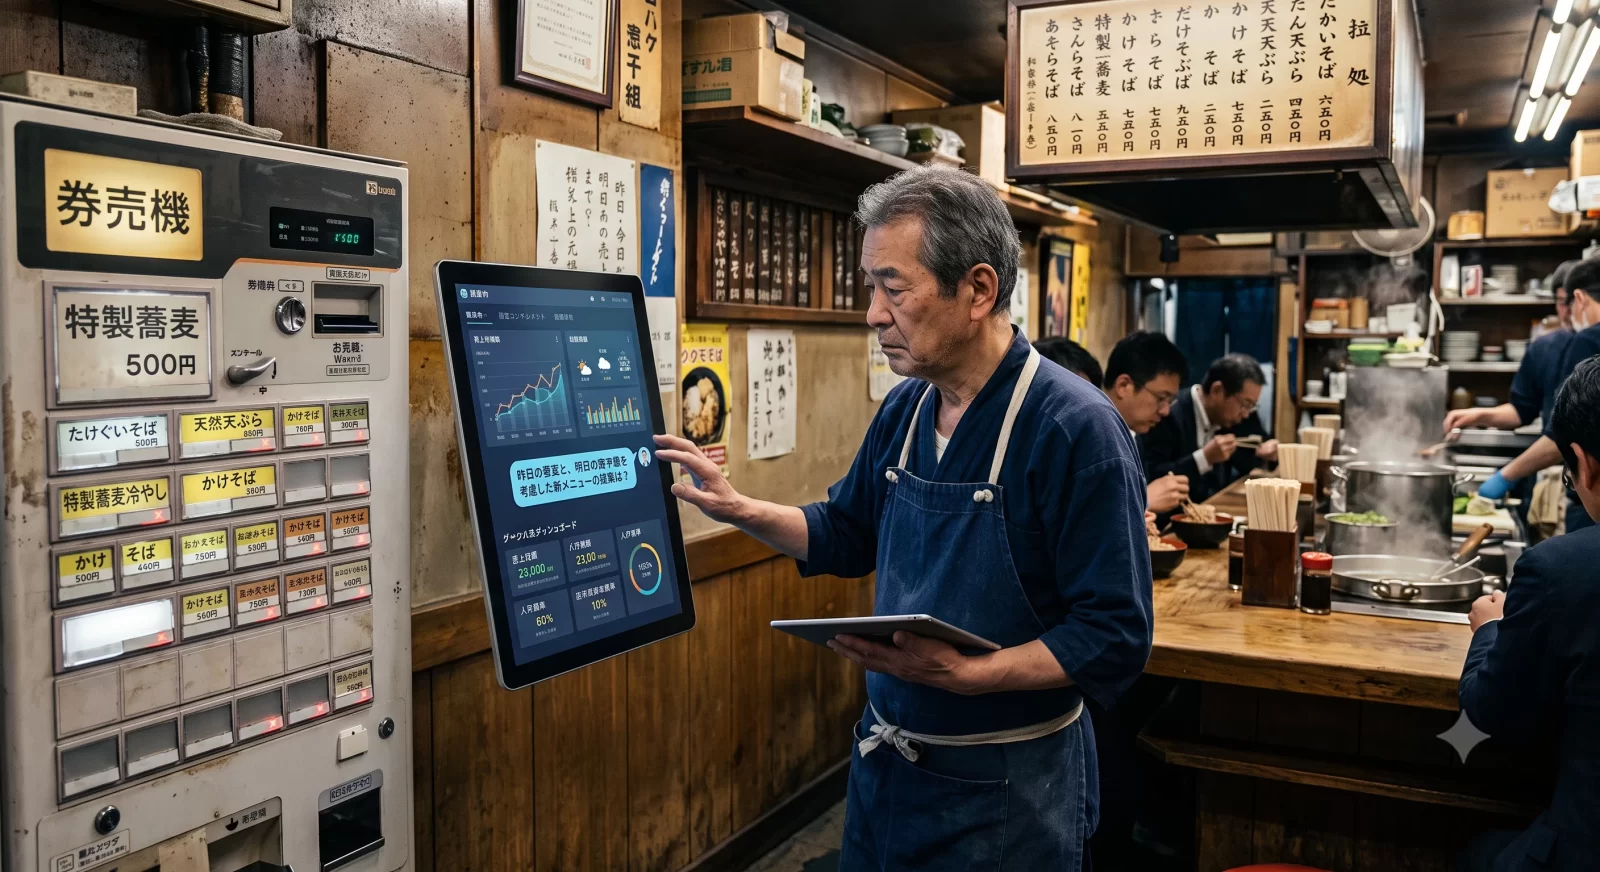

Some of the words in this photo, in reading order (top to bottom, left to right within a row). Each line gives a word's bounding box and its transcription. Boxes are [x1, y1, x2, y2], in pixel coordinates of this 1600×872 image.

[1121, 12, 1138, 92] かけそば
[1231, 2, 1249, 85] かけそば
[57, 179, 190, 235] 券売機
[65, 304, 199, 340] 特製蕎麦
[127, 353, 196, 376] 500円
[194, 412, 262, 432] 天然天ぷら
[288, 410, 320, 421] かけそば
[68, 420, 158, 442] たけぐいそば
[135, 438, 158, 447] 500円
[202, 470, 256, 490] かけそば
[63, 483, 167, 513] 特製蕎麦冷やし
[289, 519, 321, 532] かけそば
[335, 512, 364, 524] かけそば
[75, 552, 106, 571] かけ
[126, 543, 156, 562] そば
[75, 572, 100, 583] 500円
[518, 563, 546, 579] 23,000
[186, 594, 223, 610] かけそば
[591, 598, 608, 611] 10%
[536, 613, 554, 627] 60%
